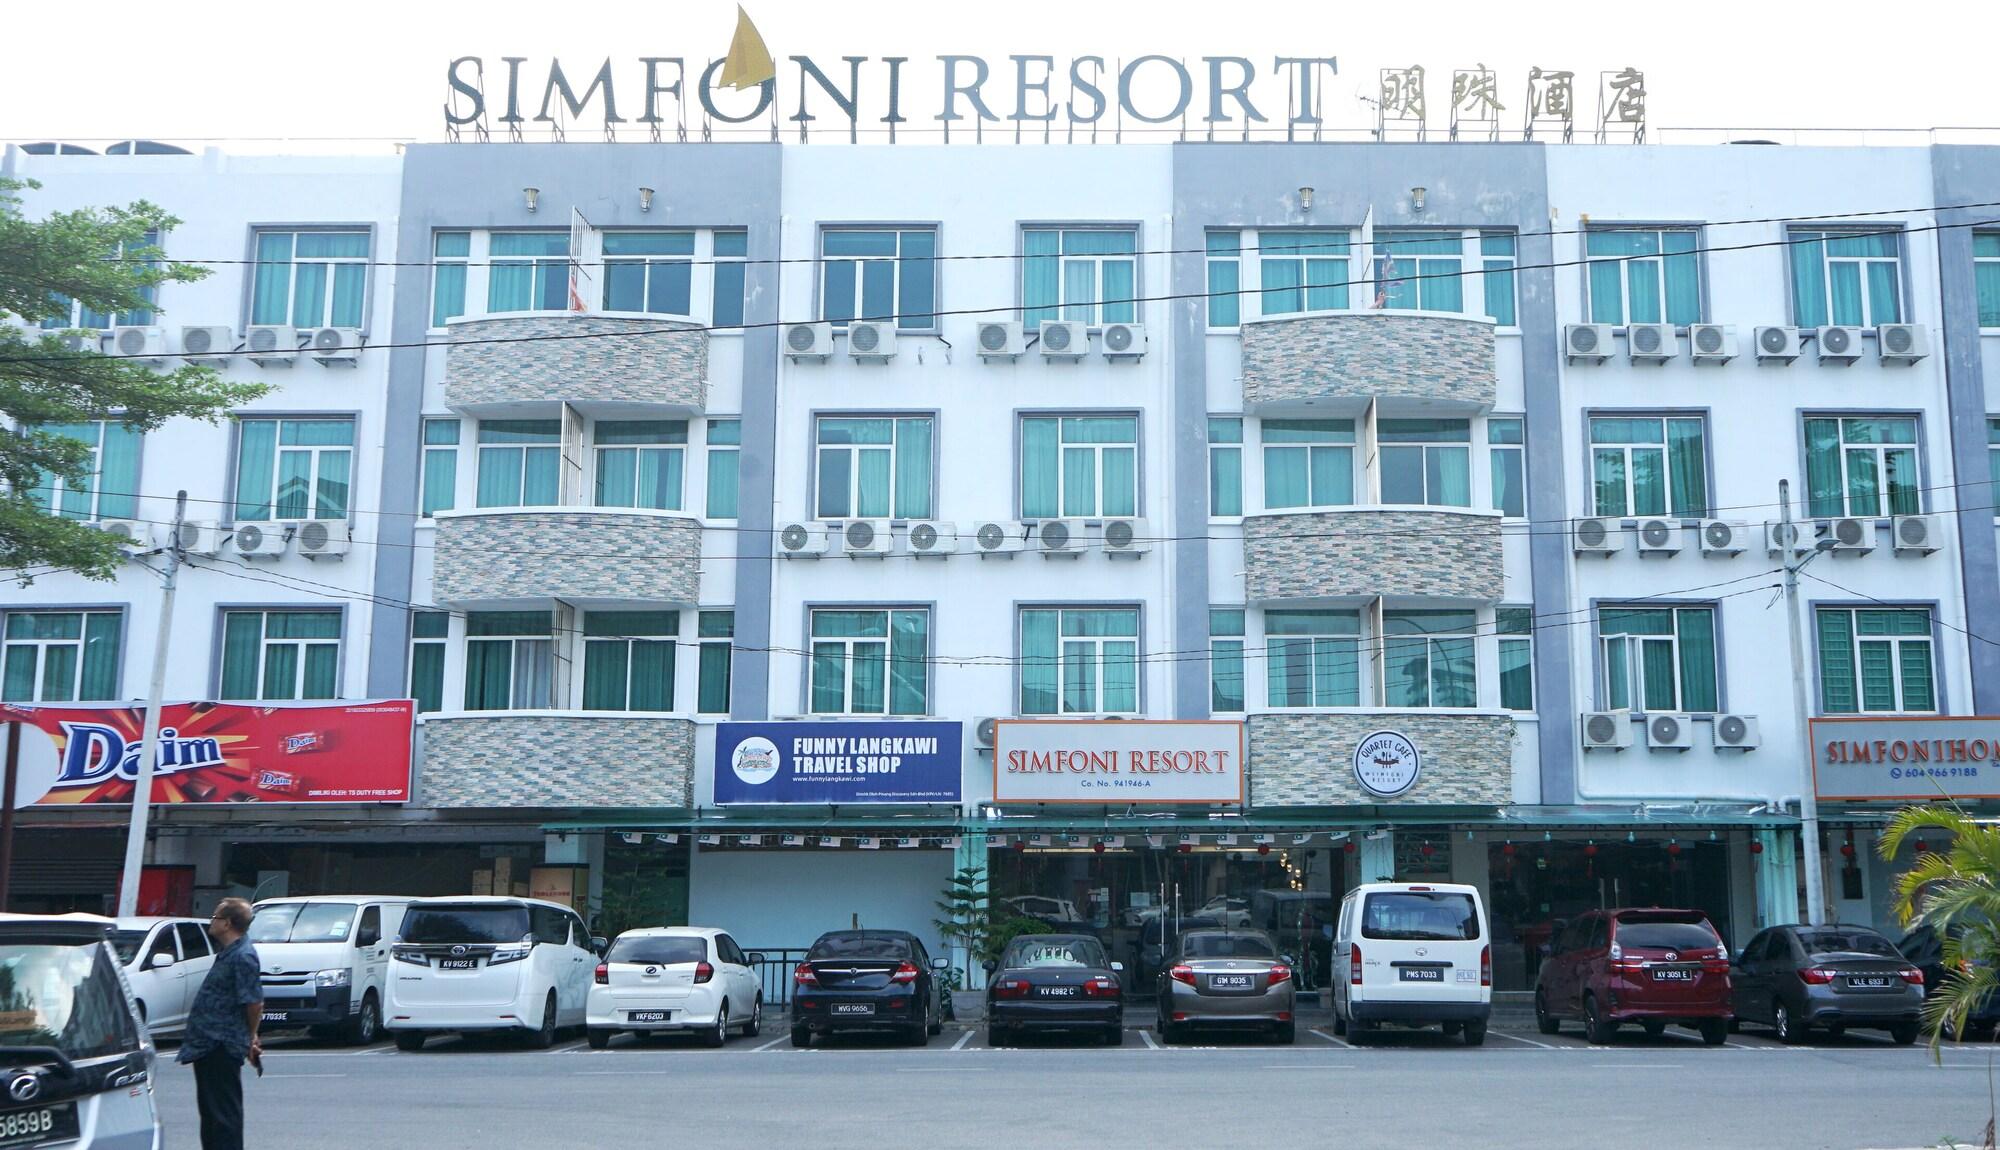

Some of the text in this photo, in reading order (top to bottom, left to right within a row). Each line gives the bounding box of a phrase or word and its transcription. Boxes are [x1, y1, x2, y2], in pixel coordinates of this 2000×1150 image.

[444, 53, 1338, 125] SIMFONI RESORT
[1380, 62, 1647, 123] 明珠酒店
[793, 737, 938, 755] FUNNY LANGKAWI
[1361, 740, 1413, 760] QUARTET CAFE
[56, 722, 223, 785] Daim
[793, 756, 853, 774] TRAVEL
[857, 756, 901, 774] SHOP
[1006, 749, 1230, 774] SIMFONI RESORT
[792, 775, 866, 783] www.funnylangkawi.com
[1905, 767, 1978, 778] 604 966 9188
[387, 788, 402, 796] SHOP
[443, 960, 474, 968] KV 9122 E
[1420, 970, 1437, 978] 7033
[1657, 970, 1666, 978] KV
[1682, 970, 1687, 978] E
[1040, 987, 1050, 996] KV
[1069, 987, 1074, 995] C
